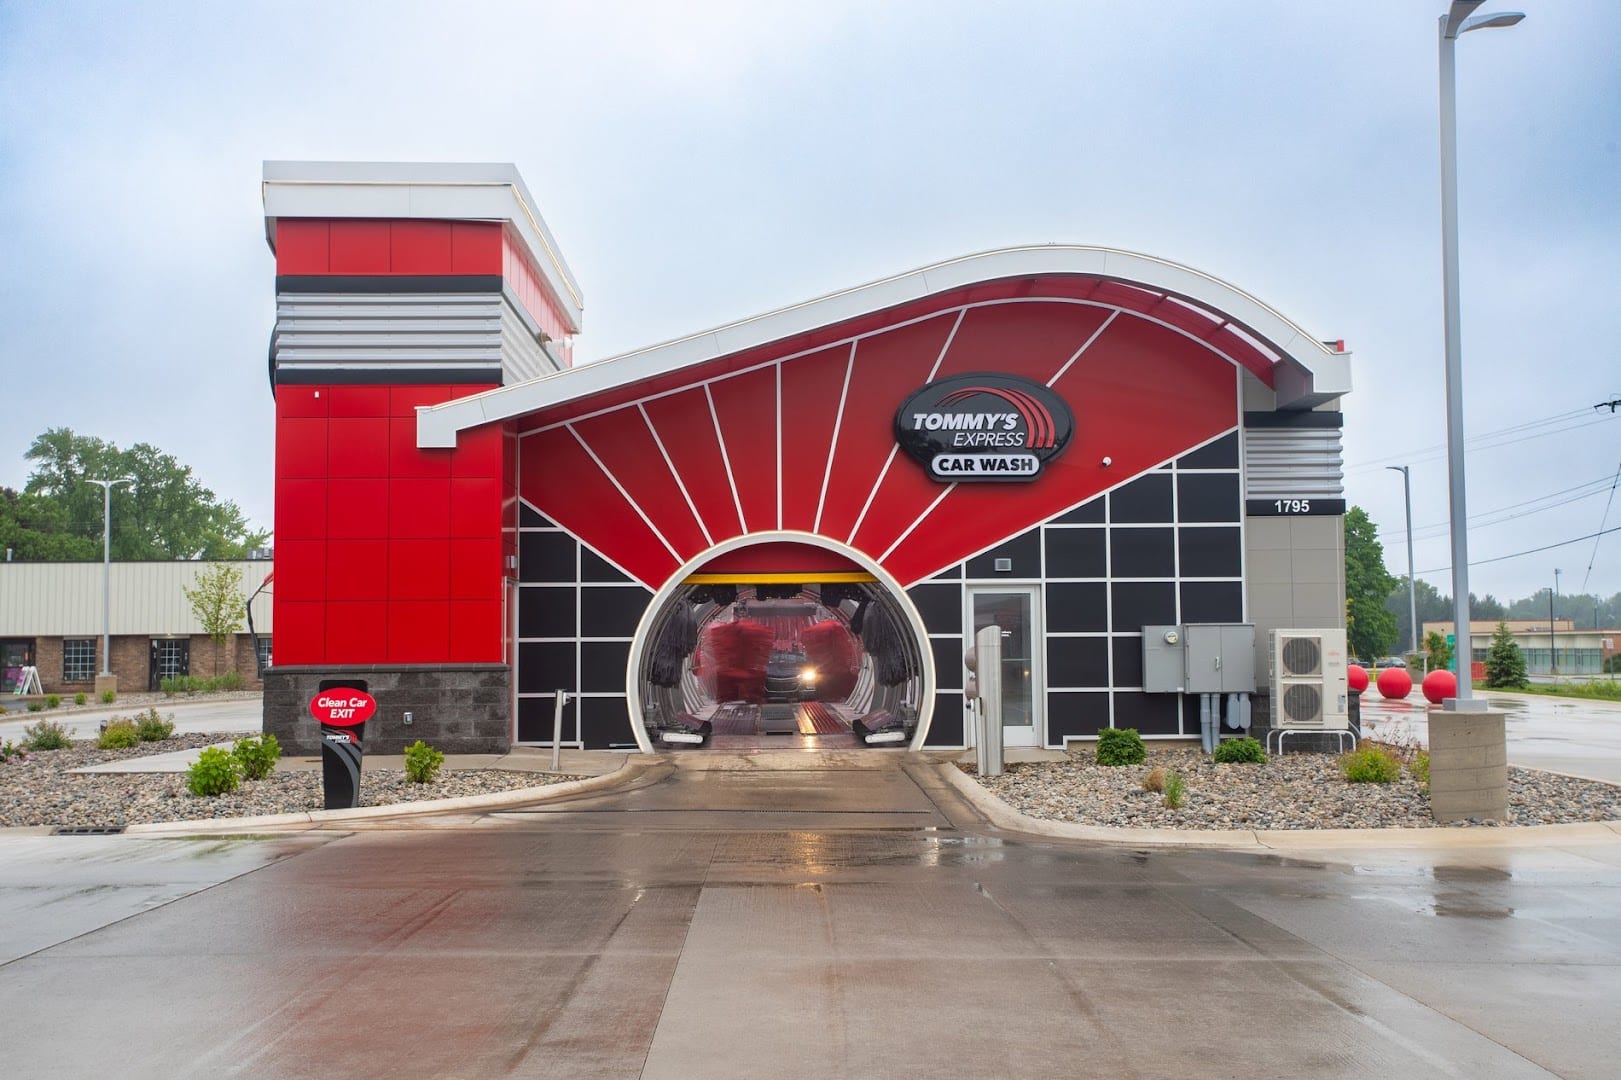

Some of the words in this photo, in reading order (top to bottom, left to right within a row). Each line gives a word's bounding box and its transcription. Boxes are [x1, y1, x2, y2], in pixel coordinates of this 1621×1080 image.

[913, 413, 1019, 430] TOMMY'S
[953, 432, 1025, 447] EXPRESS
[938, 458, 975, 471] CAR
[980, 458, 1033, 471] WASH
[1274, 499, 1310, 513] 1795
[318, 697, 347, 707] Clean
[349, 697, 367, 707] Car
[330, 709, 355, 718] EXIT
